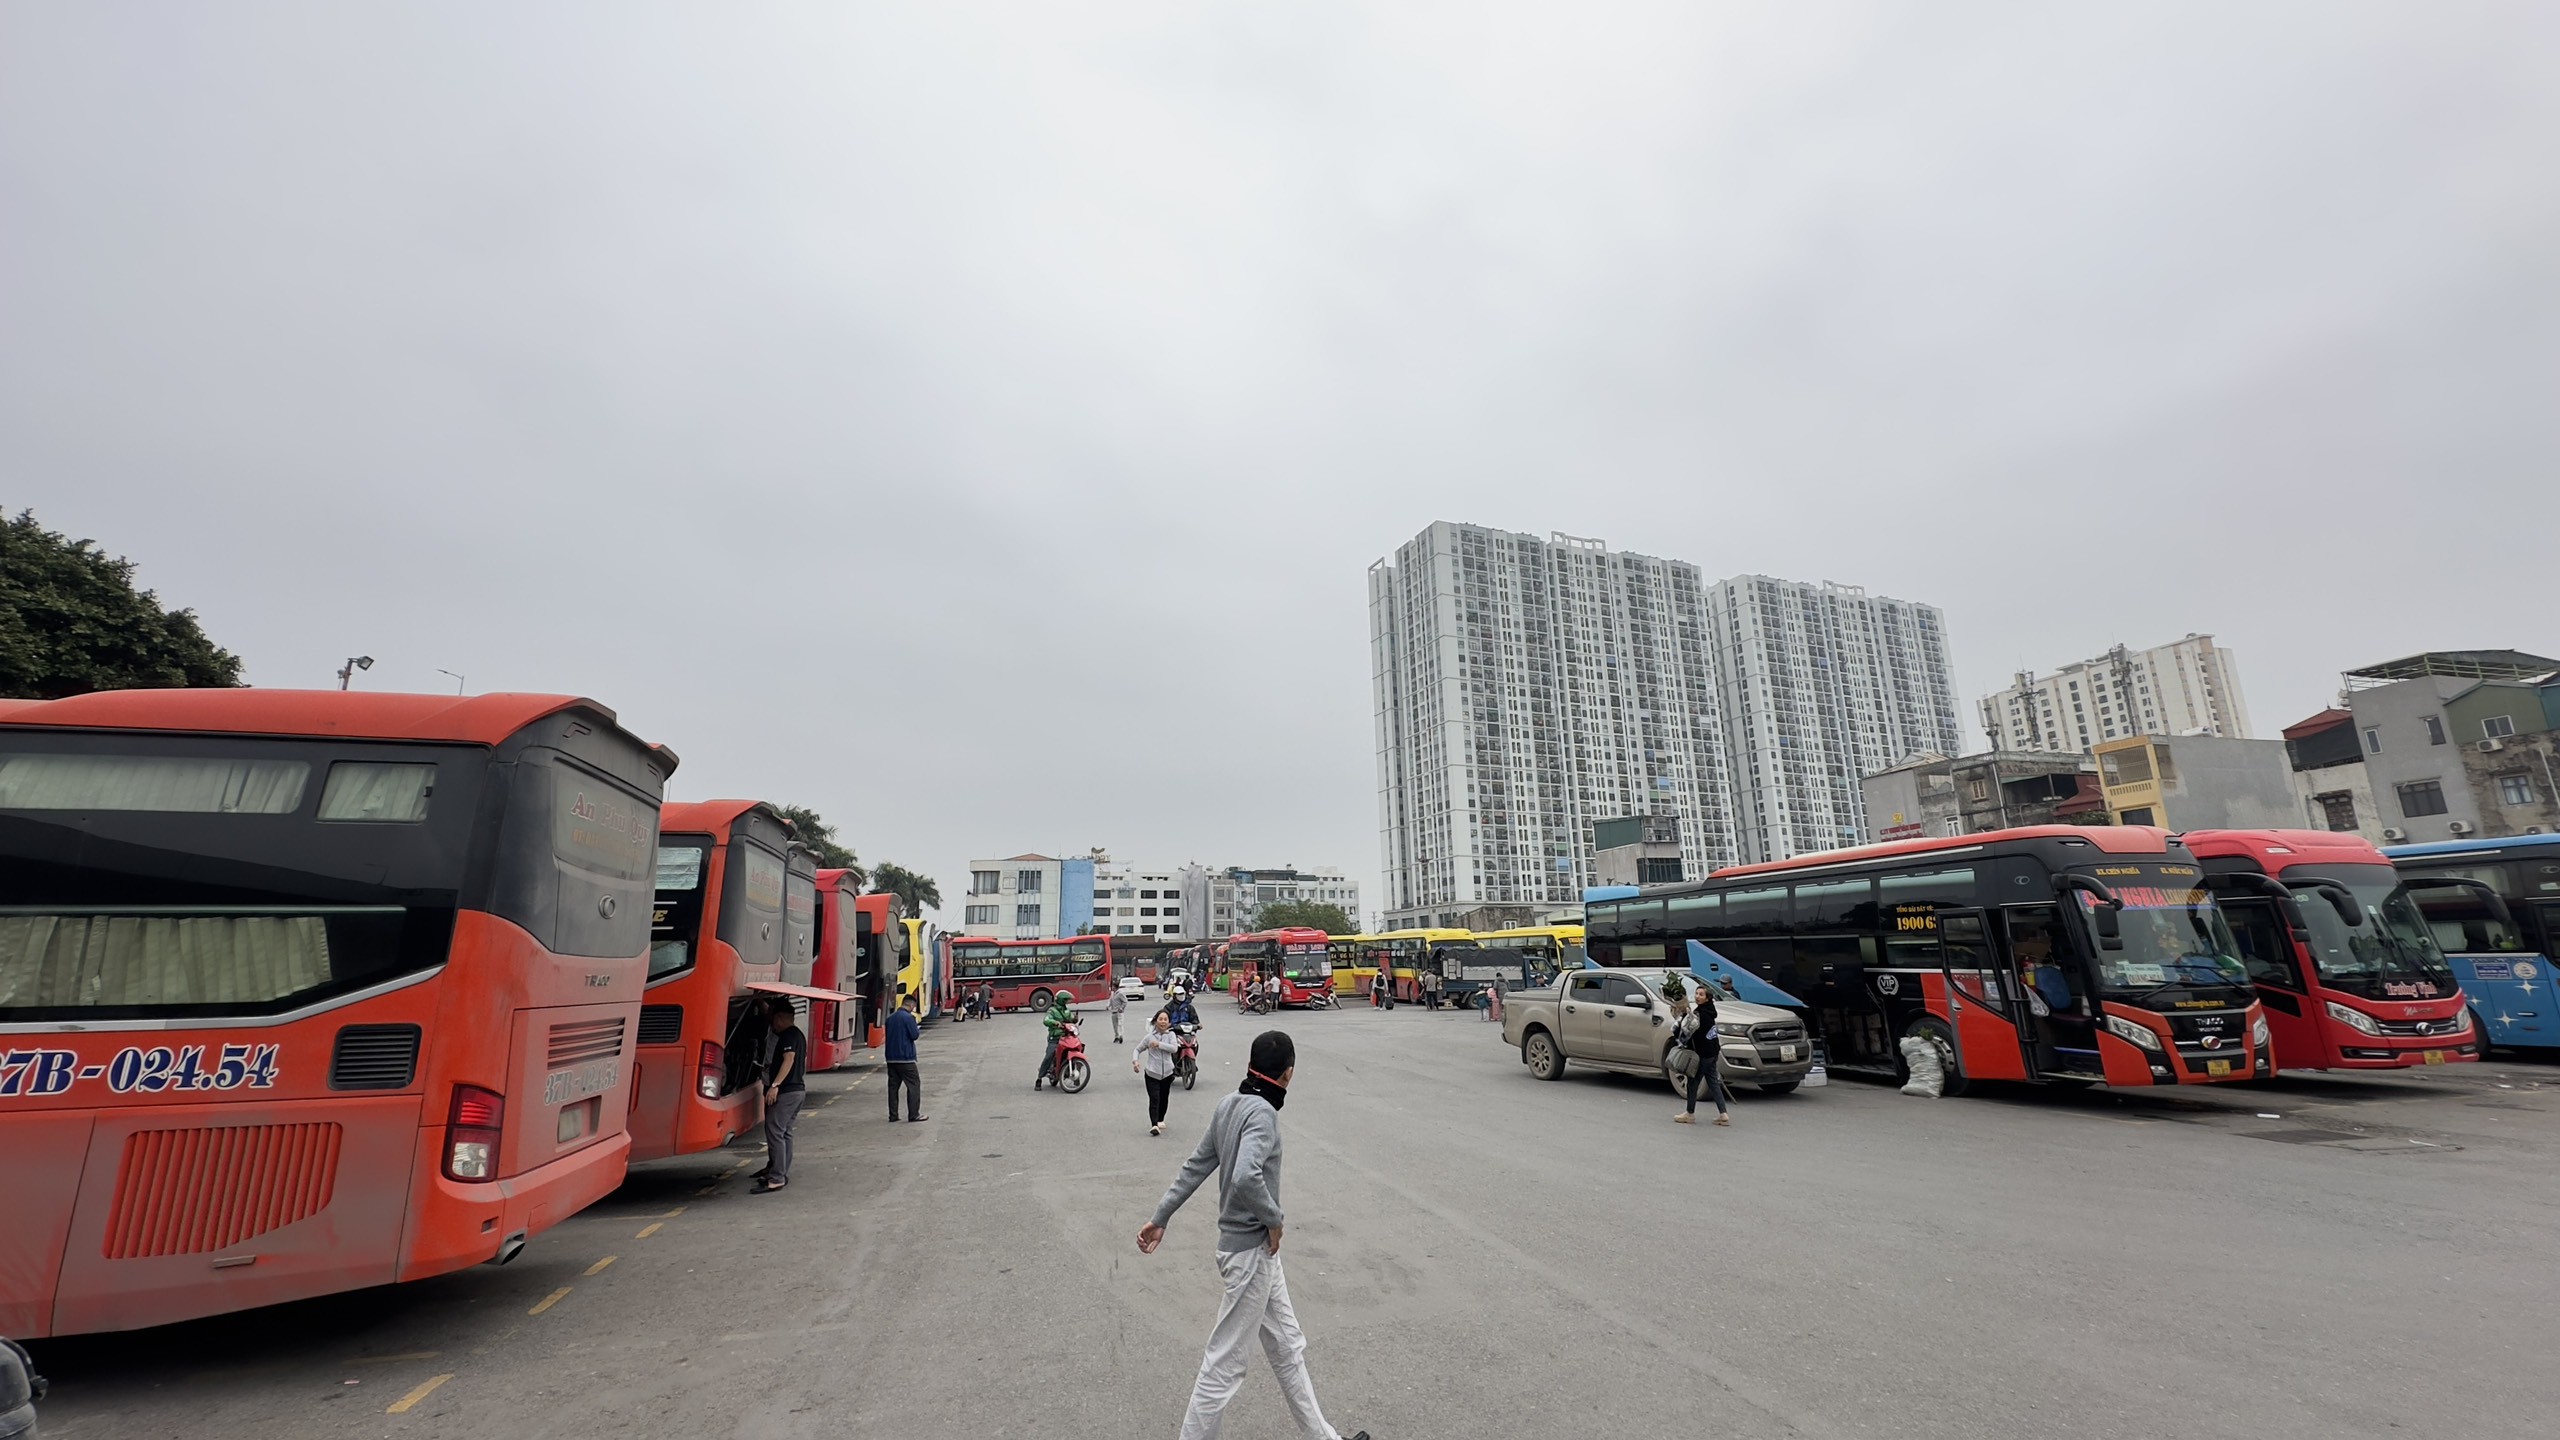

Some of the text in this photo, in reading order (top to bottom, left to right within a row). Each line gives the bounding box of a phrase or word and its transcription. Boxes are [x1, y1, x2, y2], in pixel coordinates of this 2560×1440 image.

[1896, 916, 1924, 931] 1900
[1880, 979, 1895, 987] VIP
[0, 1043, 281, 1097] 7B-024.54
